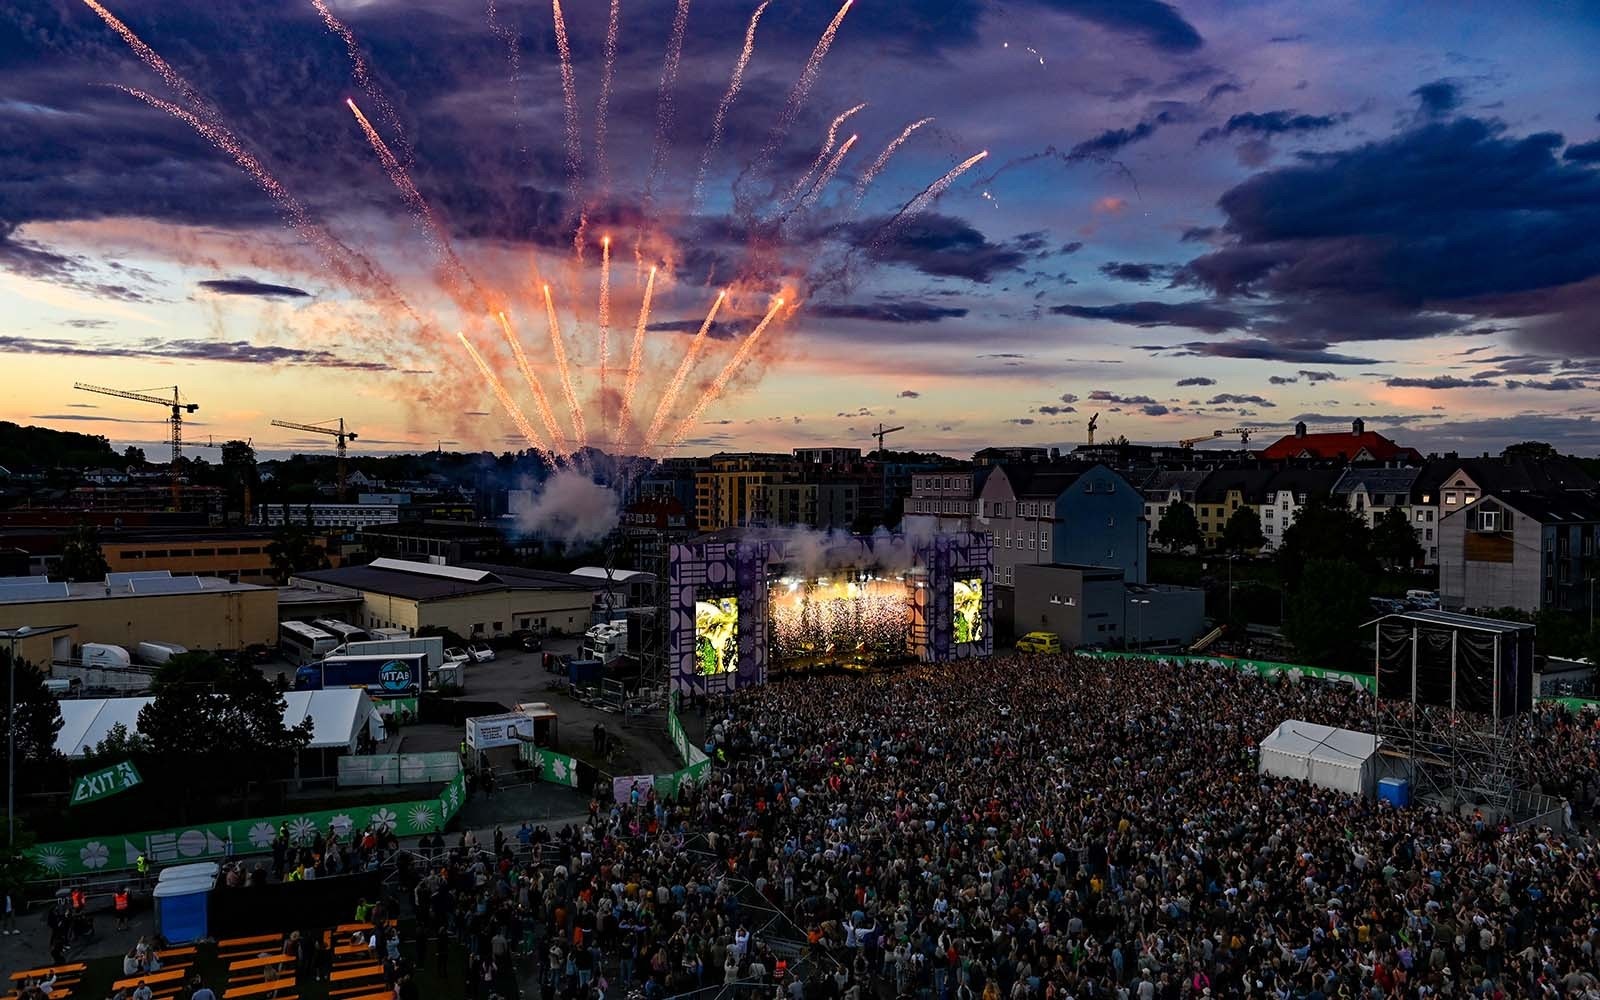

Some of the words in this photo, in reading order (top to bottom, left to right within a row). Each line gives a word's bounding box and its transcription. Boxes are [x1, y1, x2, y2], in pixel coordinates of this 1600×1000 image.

[380, 671, 410, 682] MTAB
[74, 771, 115, 801] EXIT
[124, 824, 233, 865] NEON
